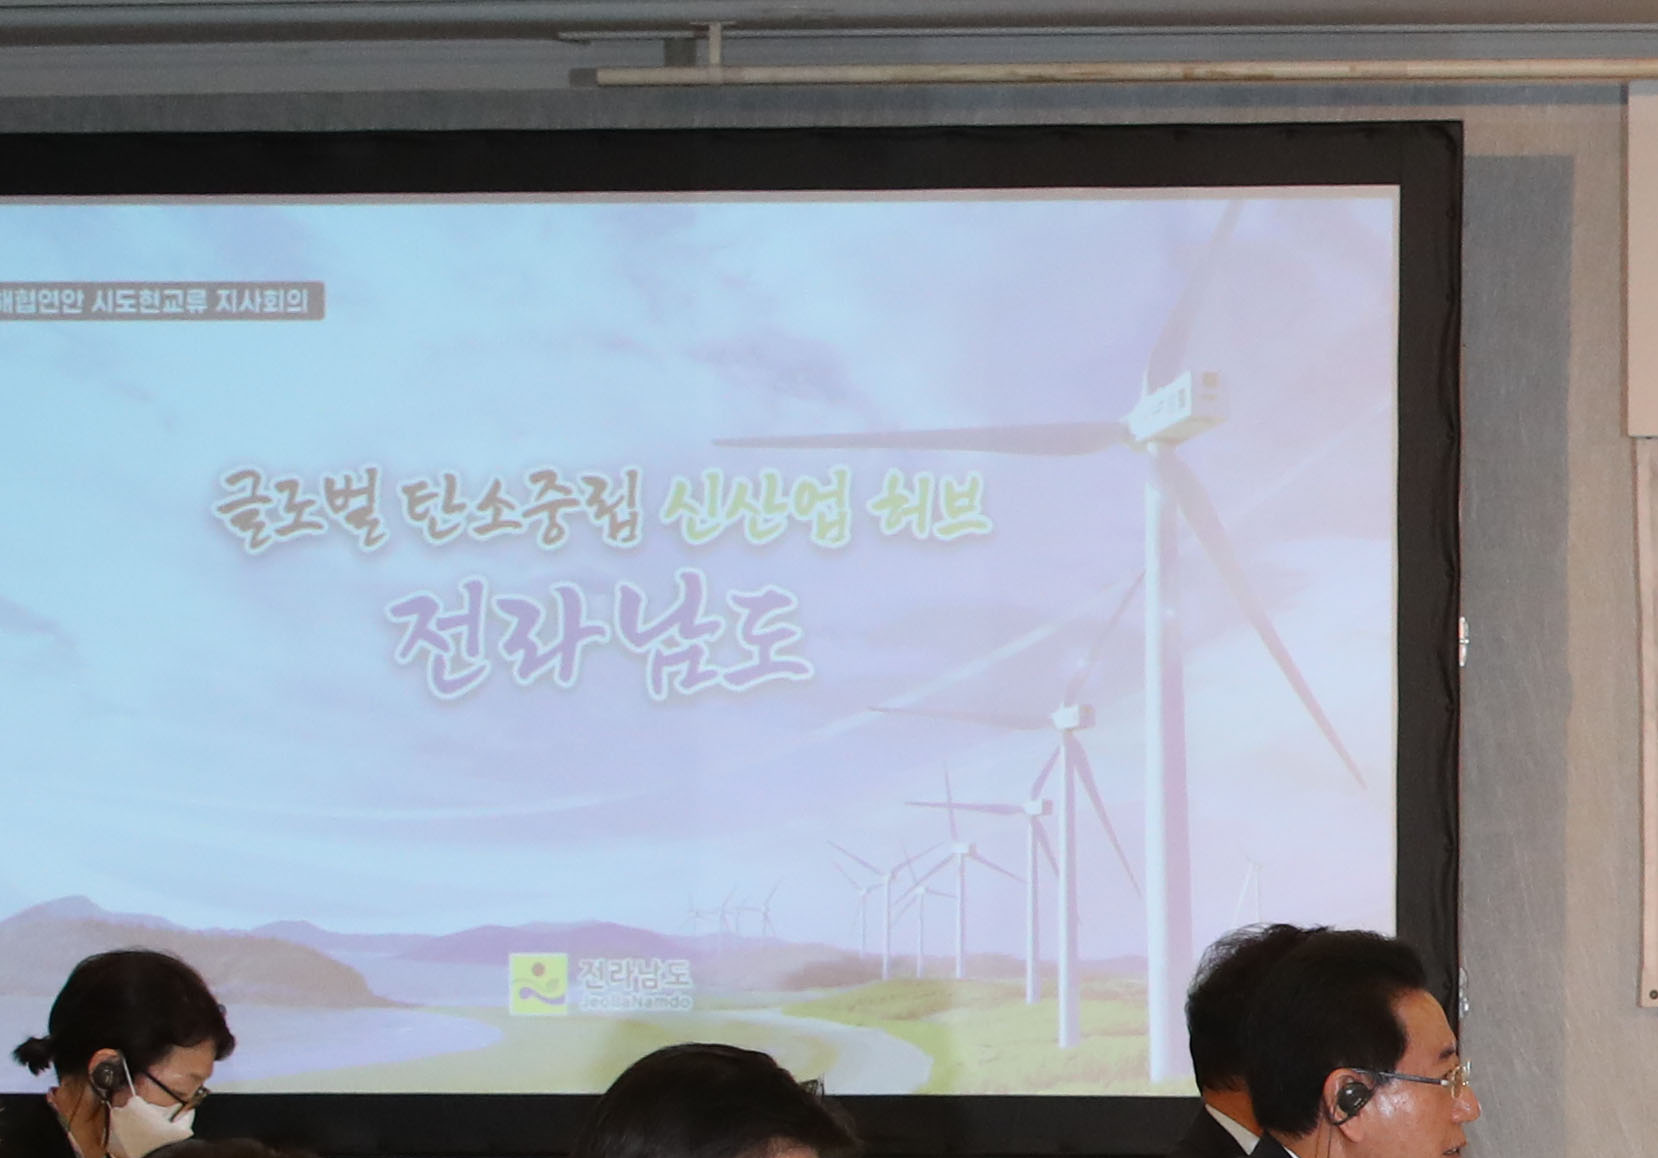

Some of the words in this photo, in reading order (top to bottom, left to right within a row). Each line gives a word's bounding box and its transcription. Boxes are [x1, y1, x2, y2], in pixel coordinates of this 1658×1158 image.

[91, 288, 208, 314] 시도현교류
[216, 288, 309, 314] 지사회의
[214, 465, 389, 551] 글로벌
[399, 467, 642, 547] 탄소중립
[661, 465, 850, 546] 신산업
[867, 469, 992, 540] 허브
[387, 570, 814, 698] 전라남도
[579, 958, 692, 991] 전라남도
